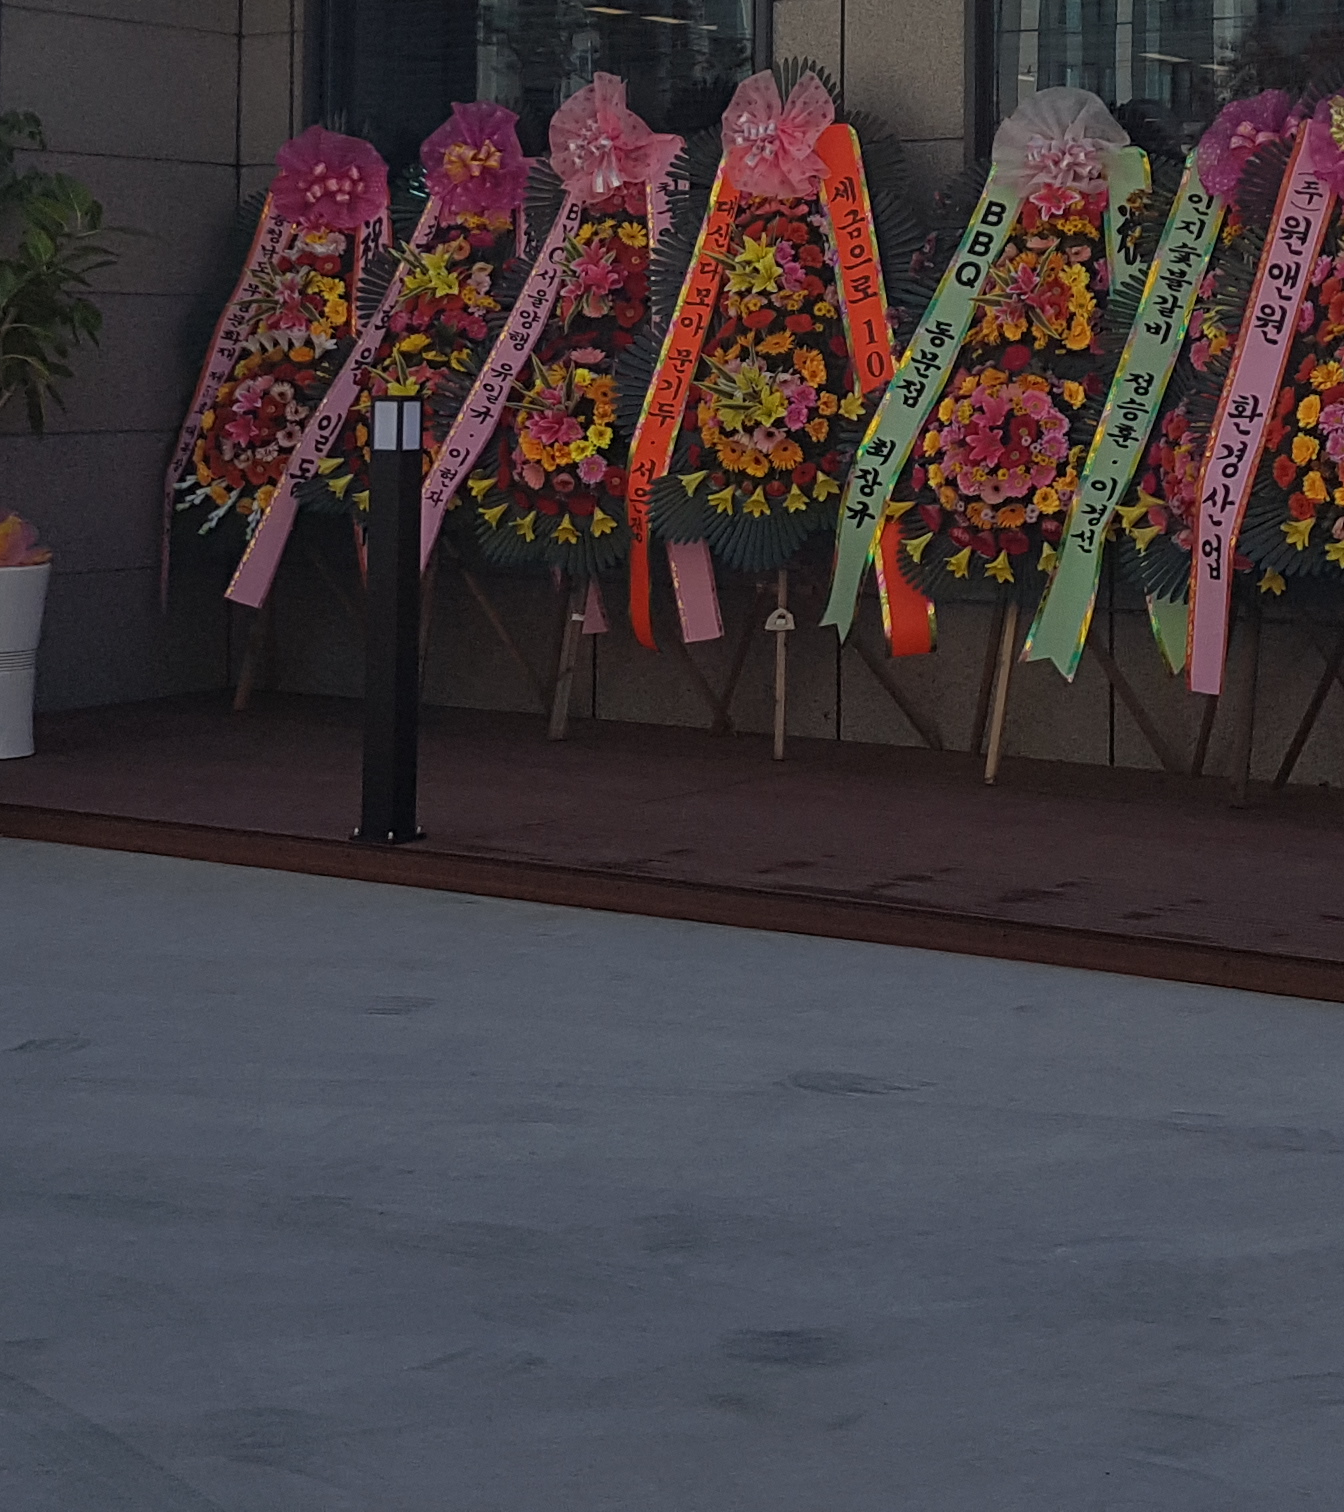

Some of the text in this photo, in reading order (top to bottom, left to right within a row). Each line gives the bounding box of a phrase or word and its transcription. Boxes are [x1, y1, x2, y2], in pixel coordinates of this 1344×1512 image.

[831, 176, 878, 304] 세금으로
[956, 200, 1007, 289] BBQ
[1201, 394, 1264, 580] 환경산업
